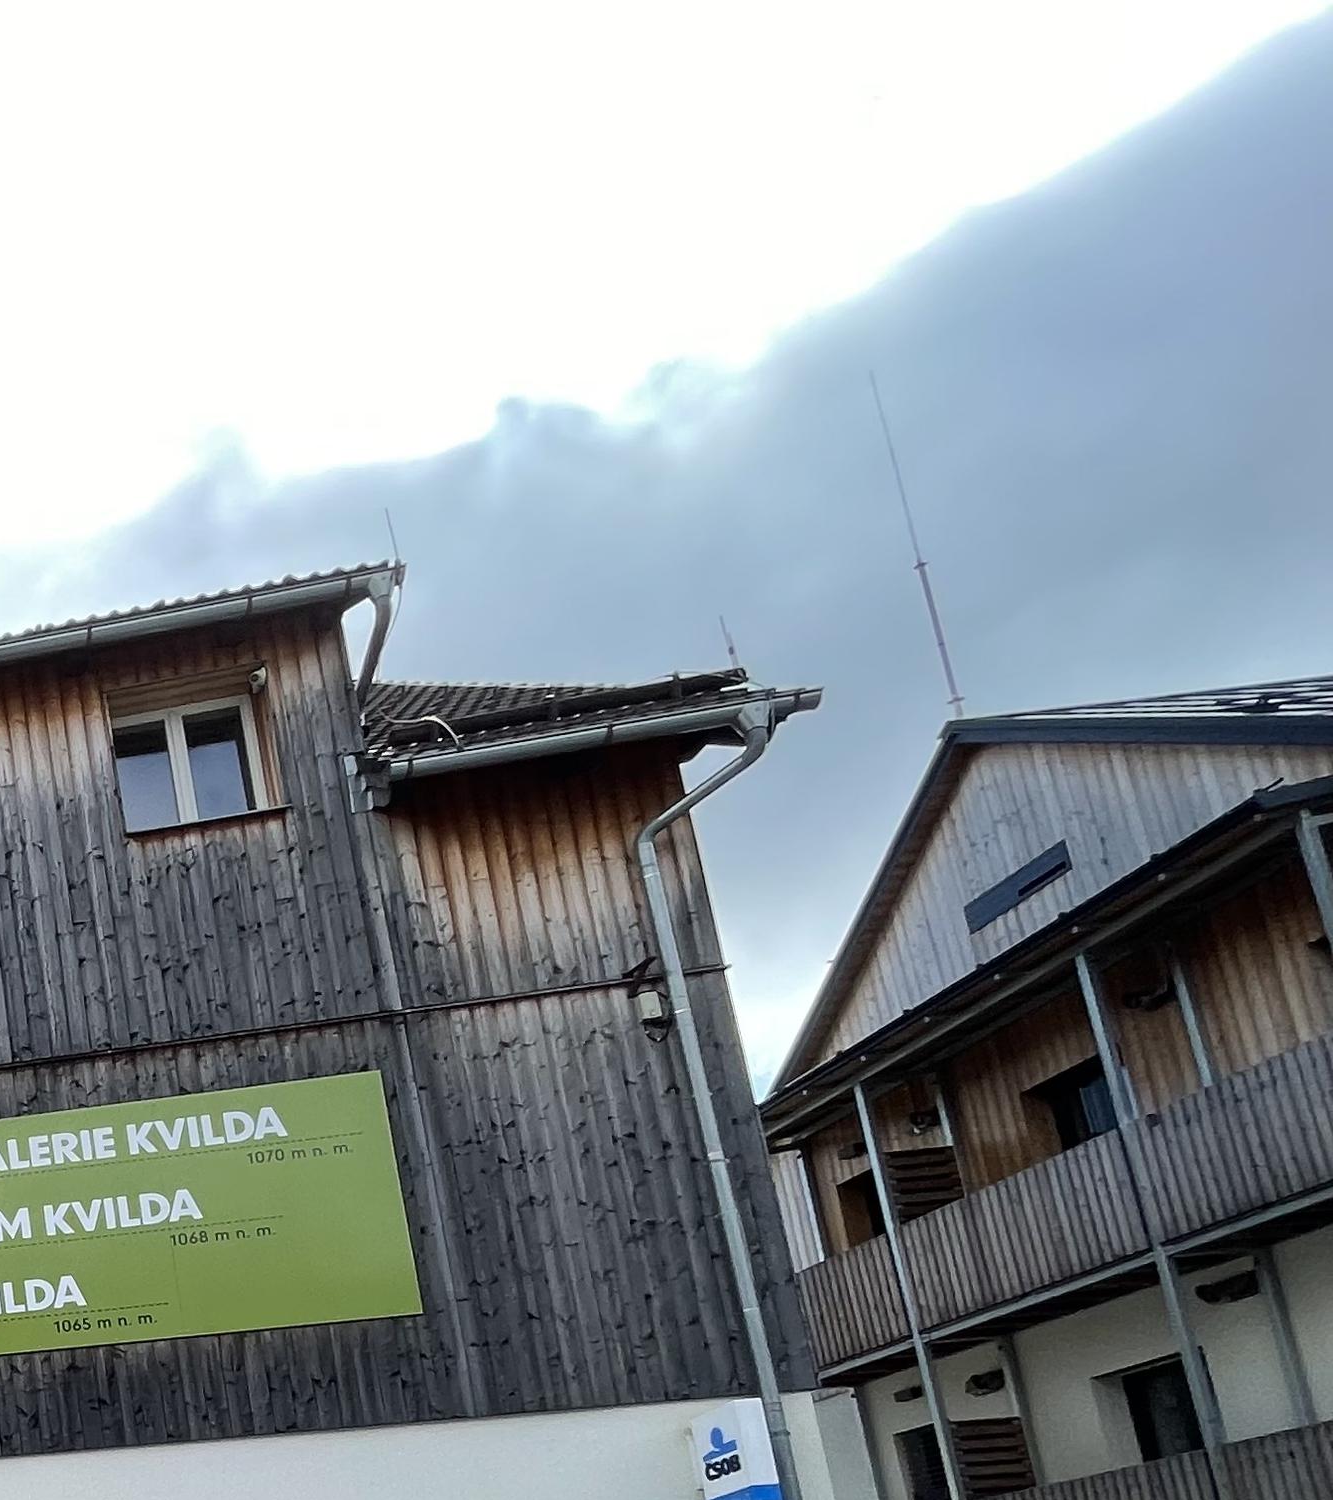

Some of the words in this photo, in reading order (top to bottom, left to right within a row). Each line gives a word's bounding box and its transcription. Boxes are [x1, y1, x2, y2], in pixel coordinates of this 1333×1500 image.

[126, 1106, 288, 1156] KVILDA
[246, 1148, 285, 1165] 1070
[291, 1148, 308, 1160] m
[333, 1143, 354, 1156] m.
[43, 1188, 204, 1237] KVILDA
[170, 1230, 209, 1247] 1068
[215, 1229, 231, 1242] m
[257, 1225, 277, 1238] m.
[53, 1318, 92, 1334] 1065
[96, 1317, 113, 1330] m
[137, 1314, 158, 1326] m.
